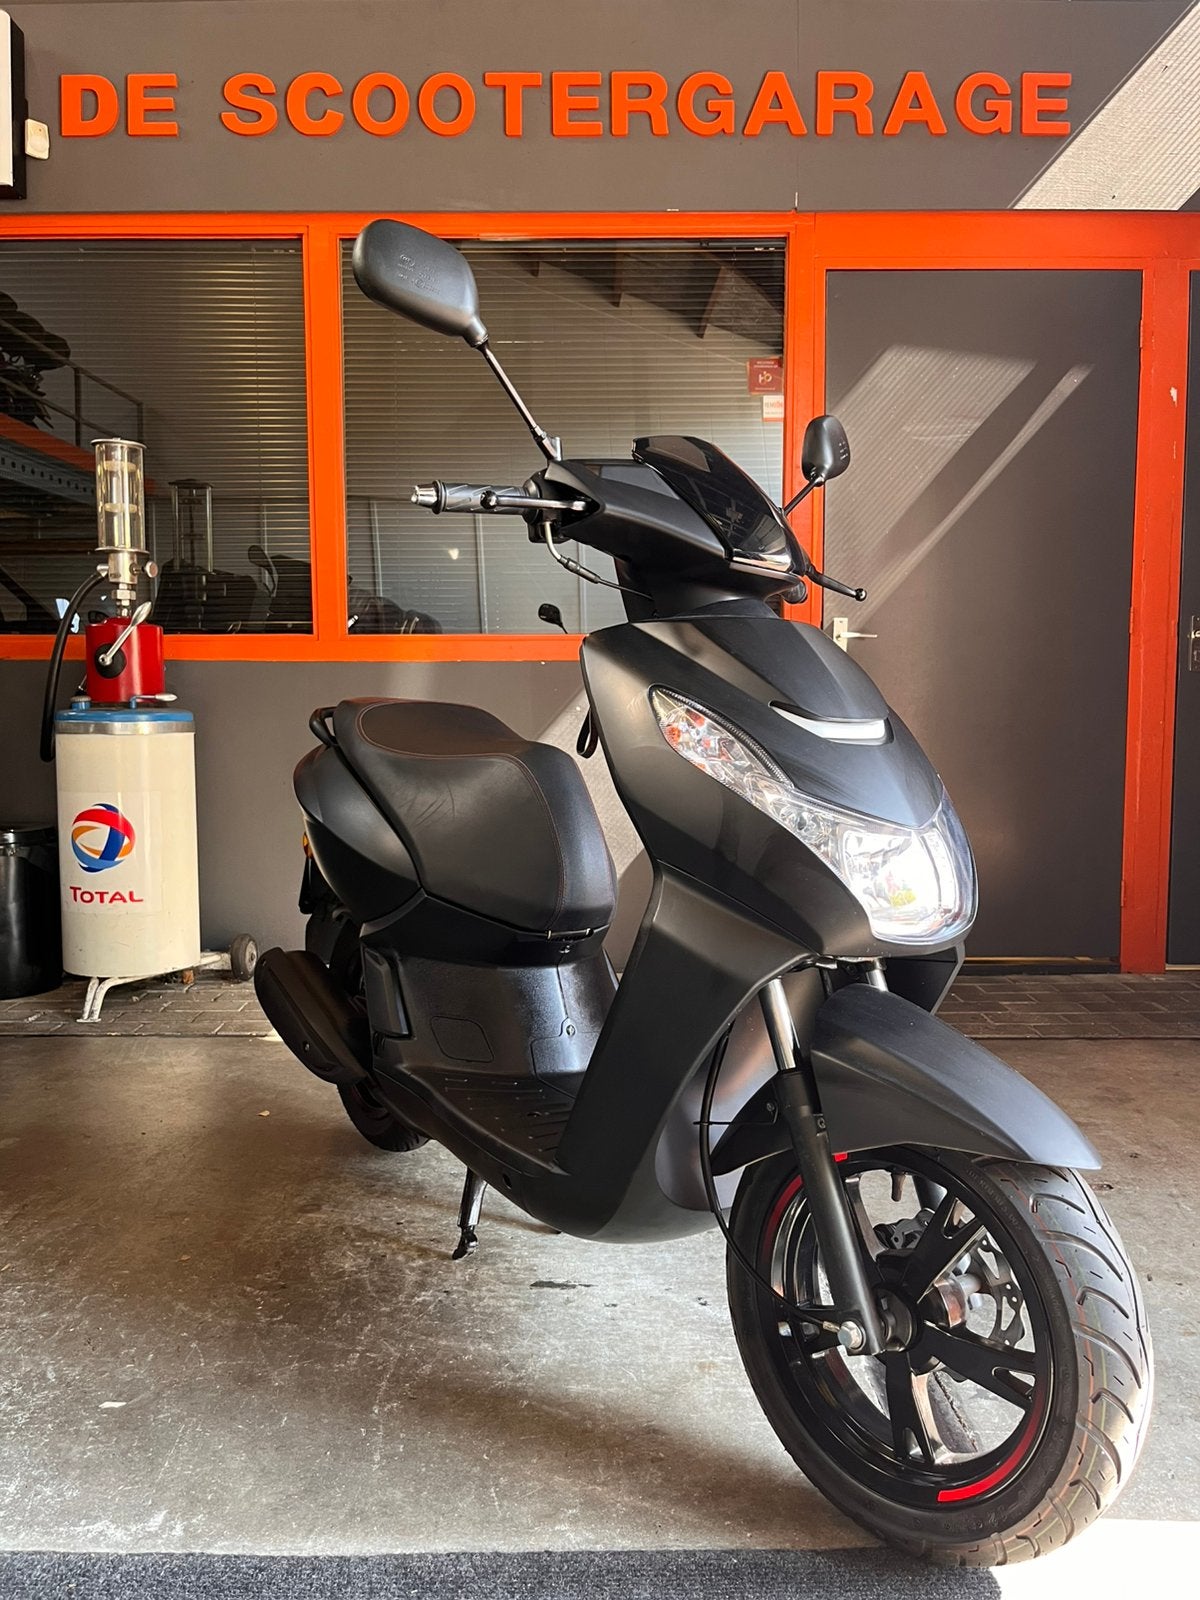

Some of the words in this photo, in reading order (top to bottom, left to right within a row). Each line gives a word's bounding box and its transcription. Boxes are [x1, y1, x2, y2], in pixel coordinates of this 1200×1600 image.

[61, 74, 179, 138] DE
[221, 71, 1071, 138] SCOOTERGARAGE
[70, 886, 144, 903] TOTAL
